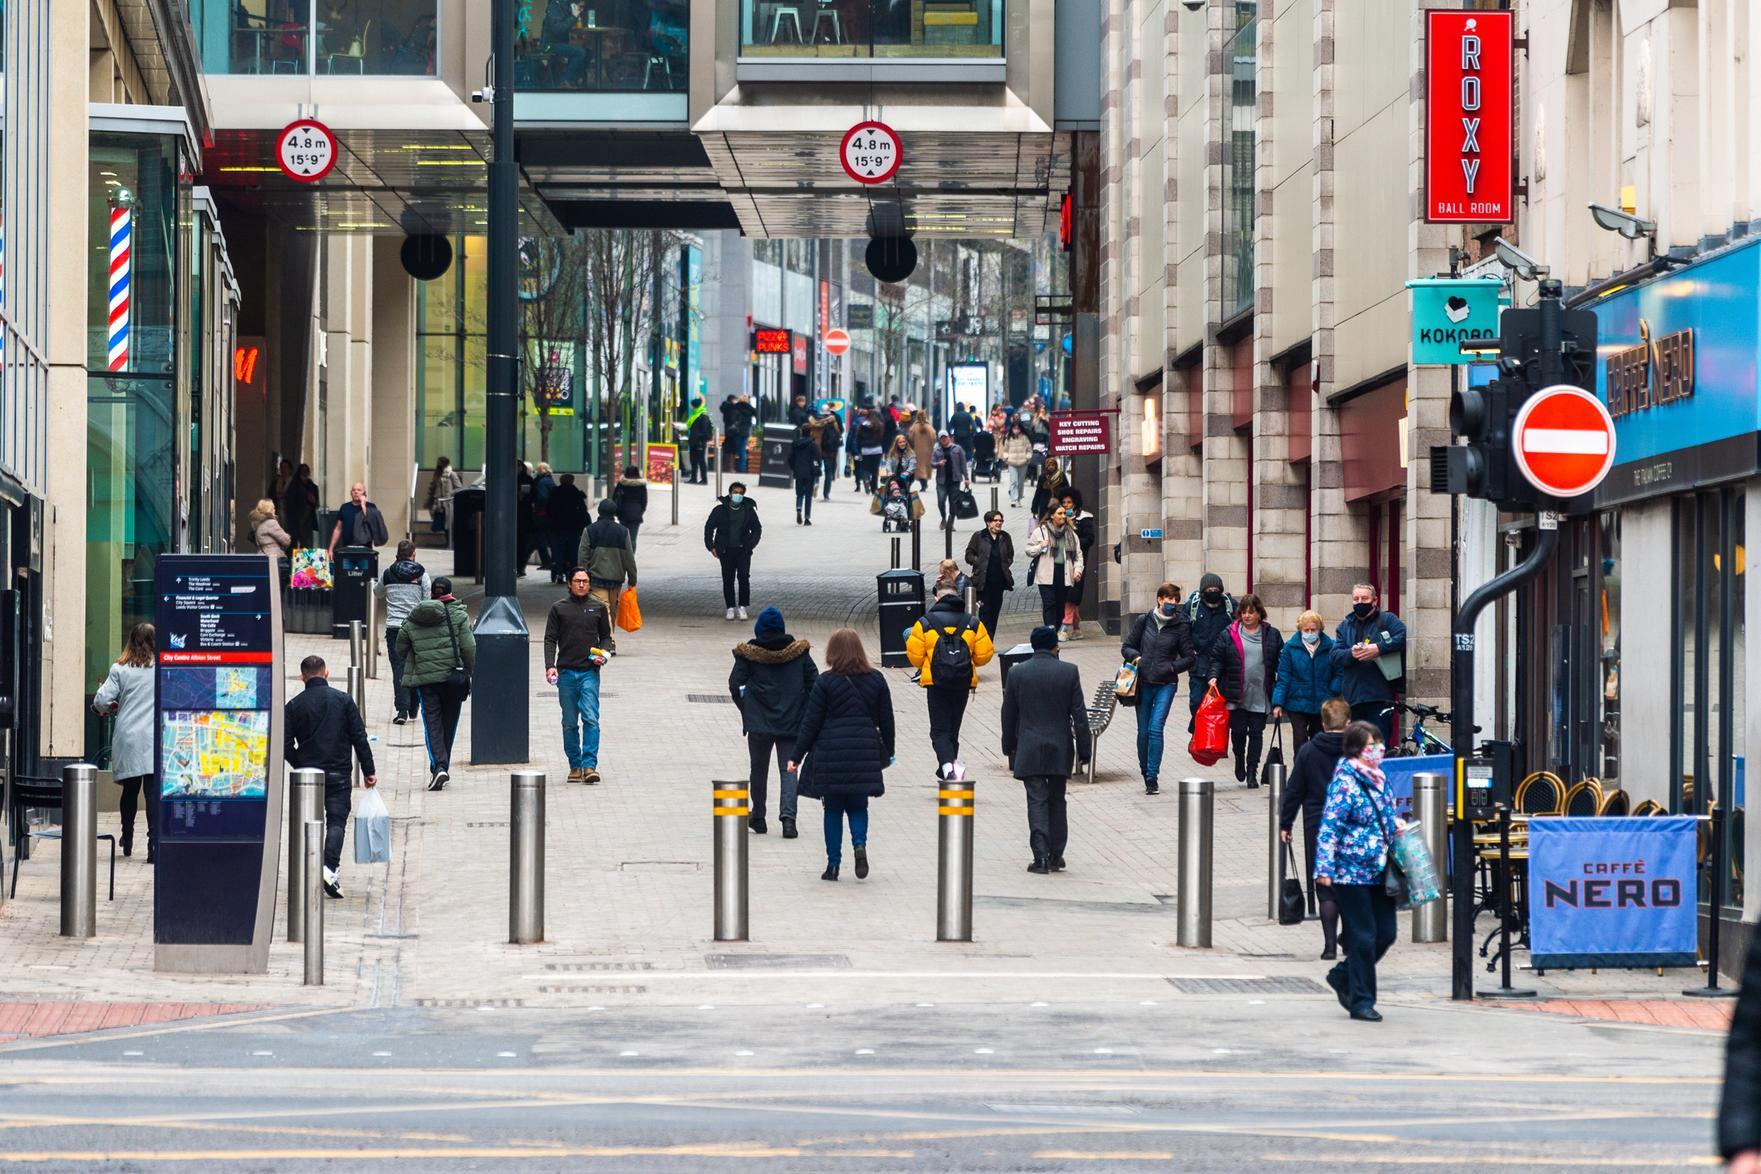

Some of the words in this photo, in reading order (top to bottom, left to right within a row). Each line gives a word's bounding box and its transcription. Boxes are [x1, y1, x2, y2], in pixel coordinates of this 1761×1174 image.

[1461, 35, 1481, 194] ROXY
[1438, 202, 1464, 214] BALL
[1471, 202, 1501, 214] ROOM
[757, 342, 790, 352] PUNKS
[1652, 328, 1693, 407] NERO
[1583, 860, 1645, 874] CAFFÈ
[1545, 879, 1681, 908] NERO
